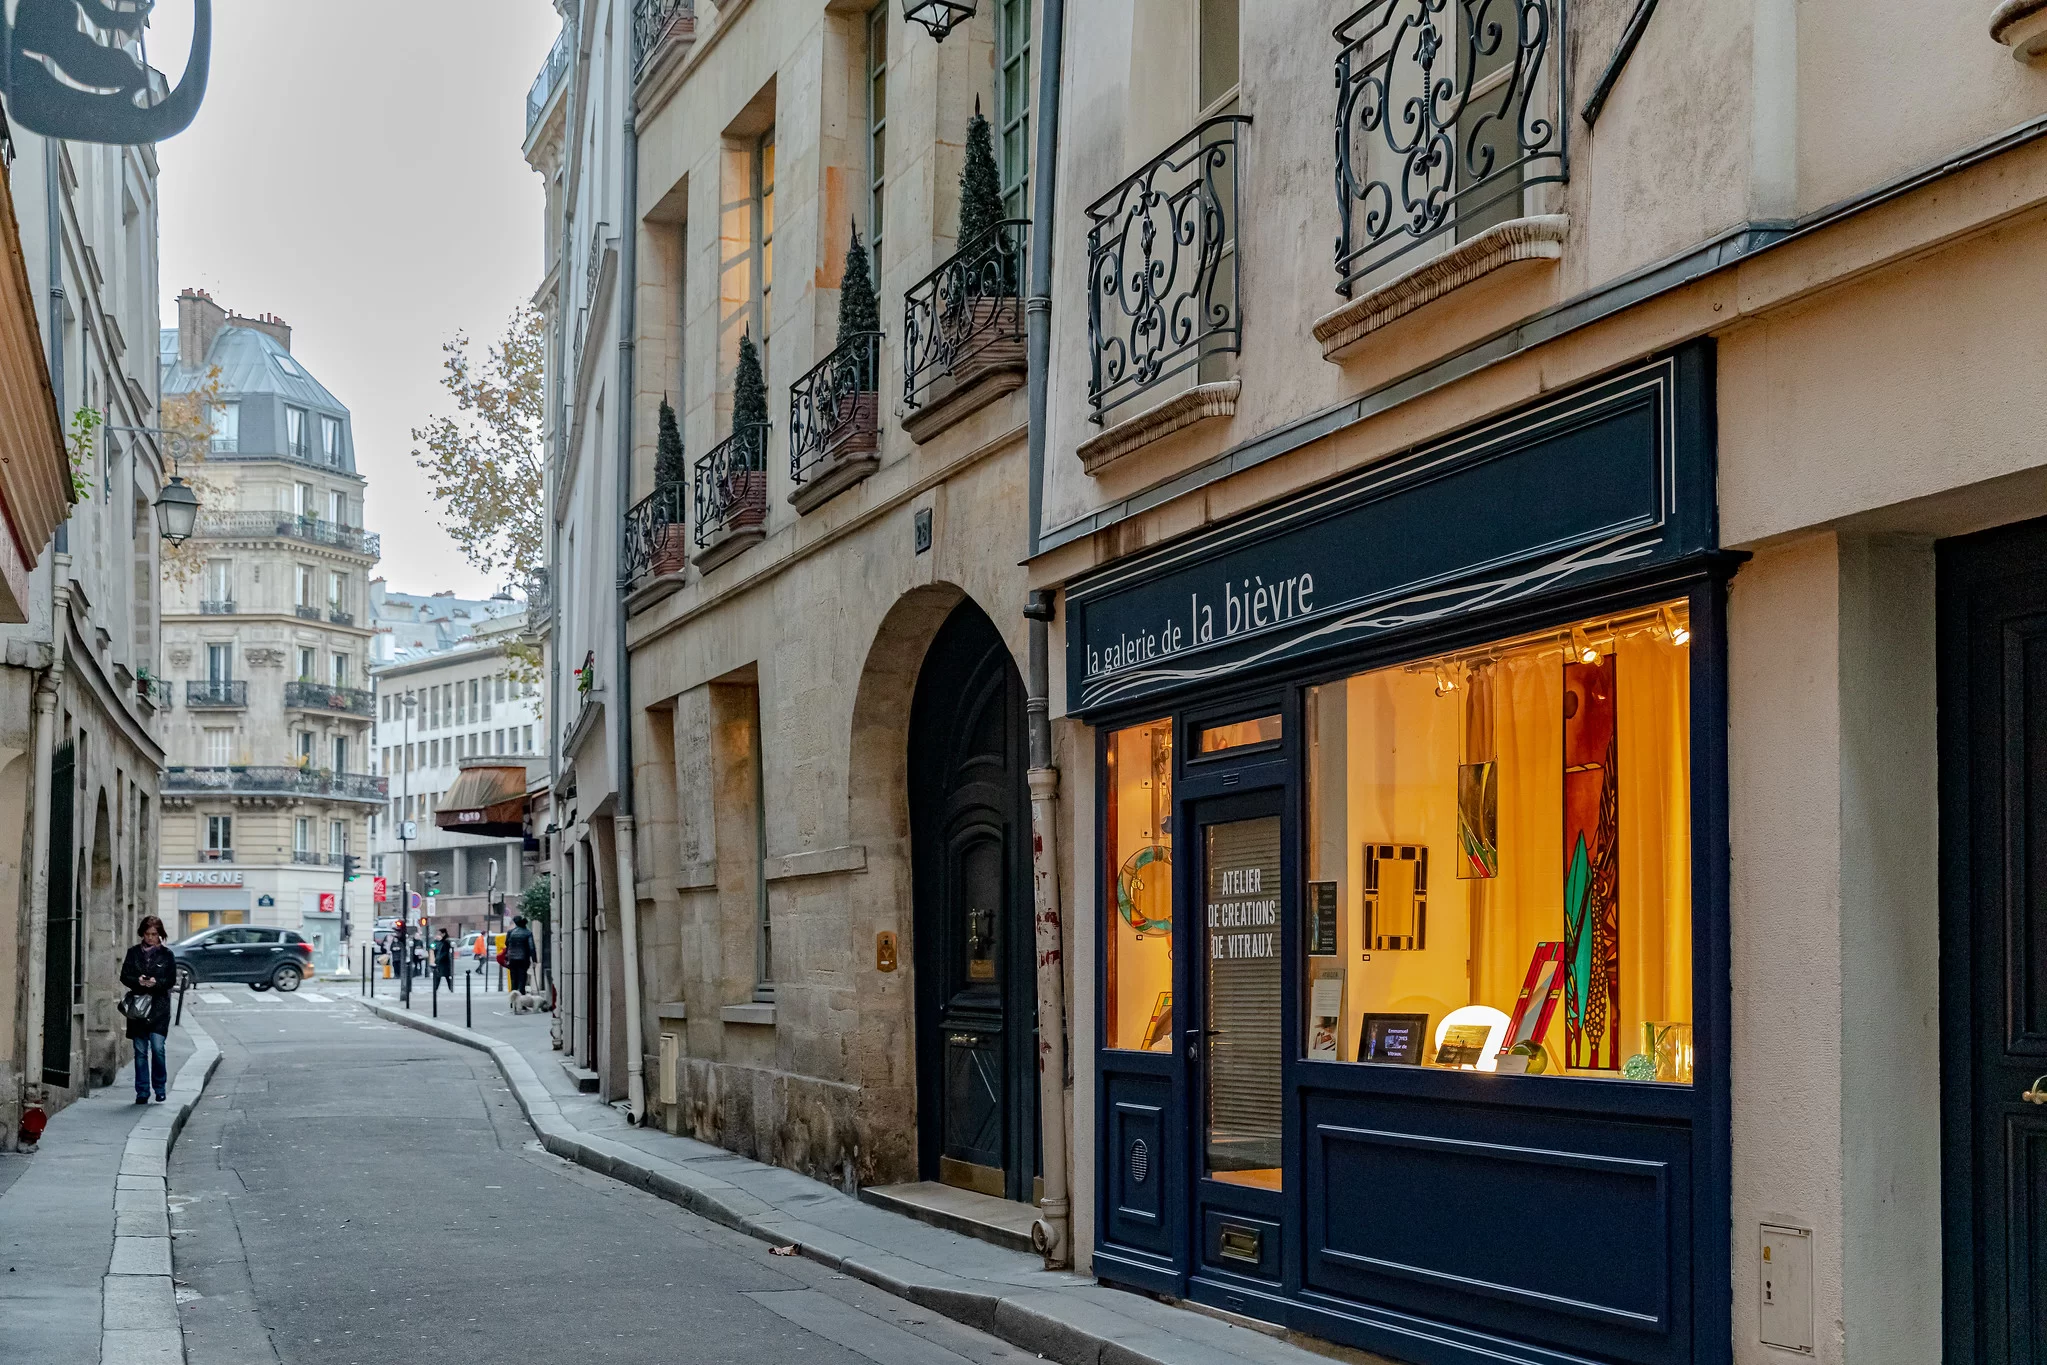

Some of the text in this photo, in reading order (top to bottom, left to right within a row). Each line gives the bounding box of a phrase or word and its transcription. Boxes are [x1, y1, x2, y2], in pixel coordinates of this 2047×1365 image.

[1087, 572, 1314, 675] la galerie de la bièvre
[1222, 868, 1261, 895] ATELIER
[1208, 899, 1276, 928] DE CREATIONS
[1212, 932, 1274, 959] DE VITRAUX
